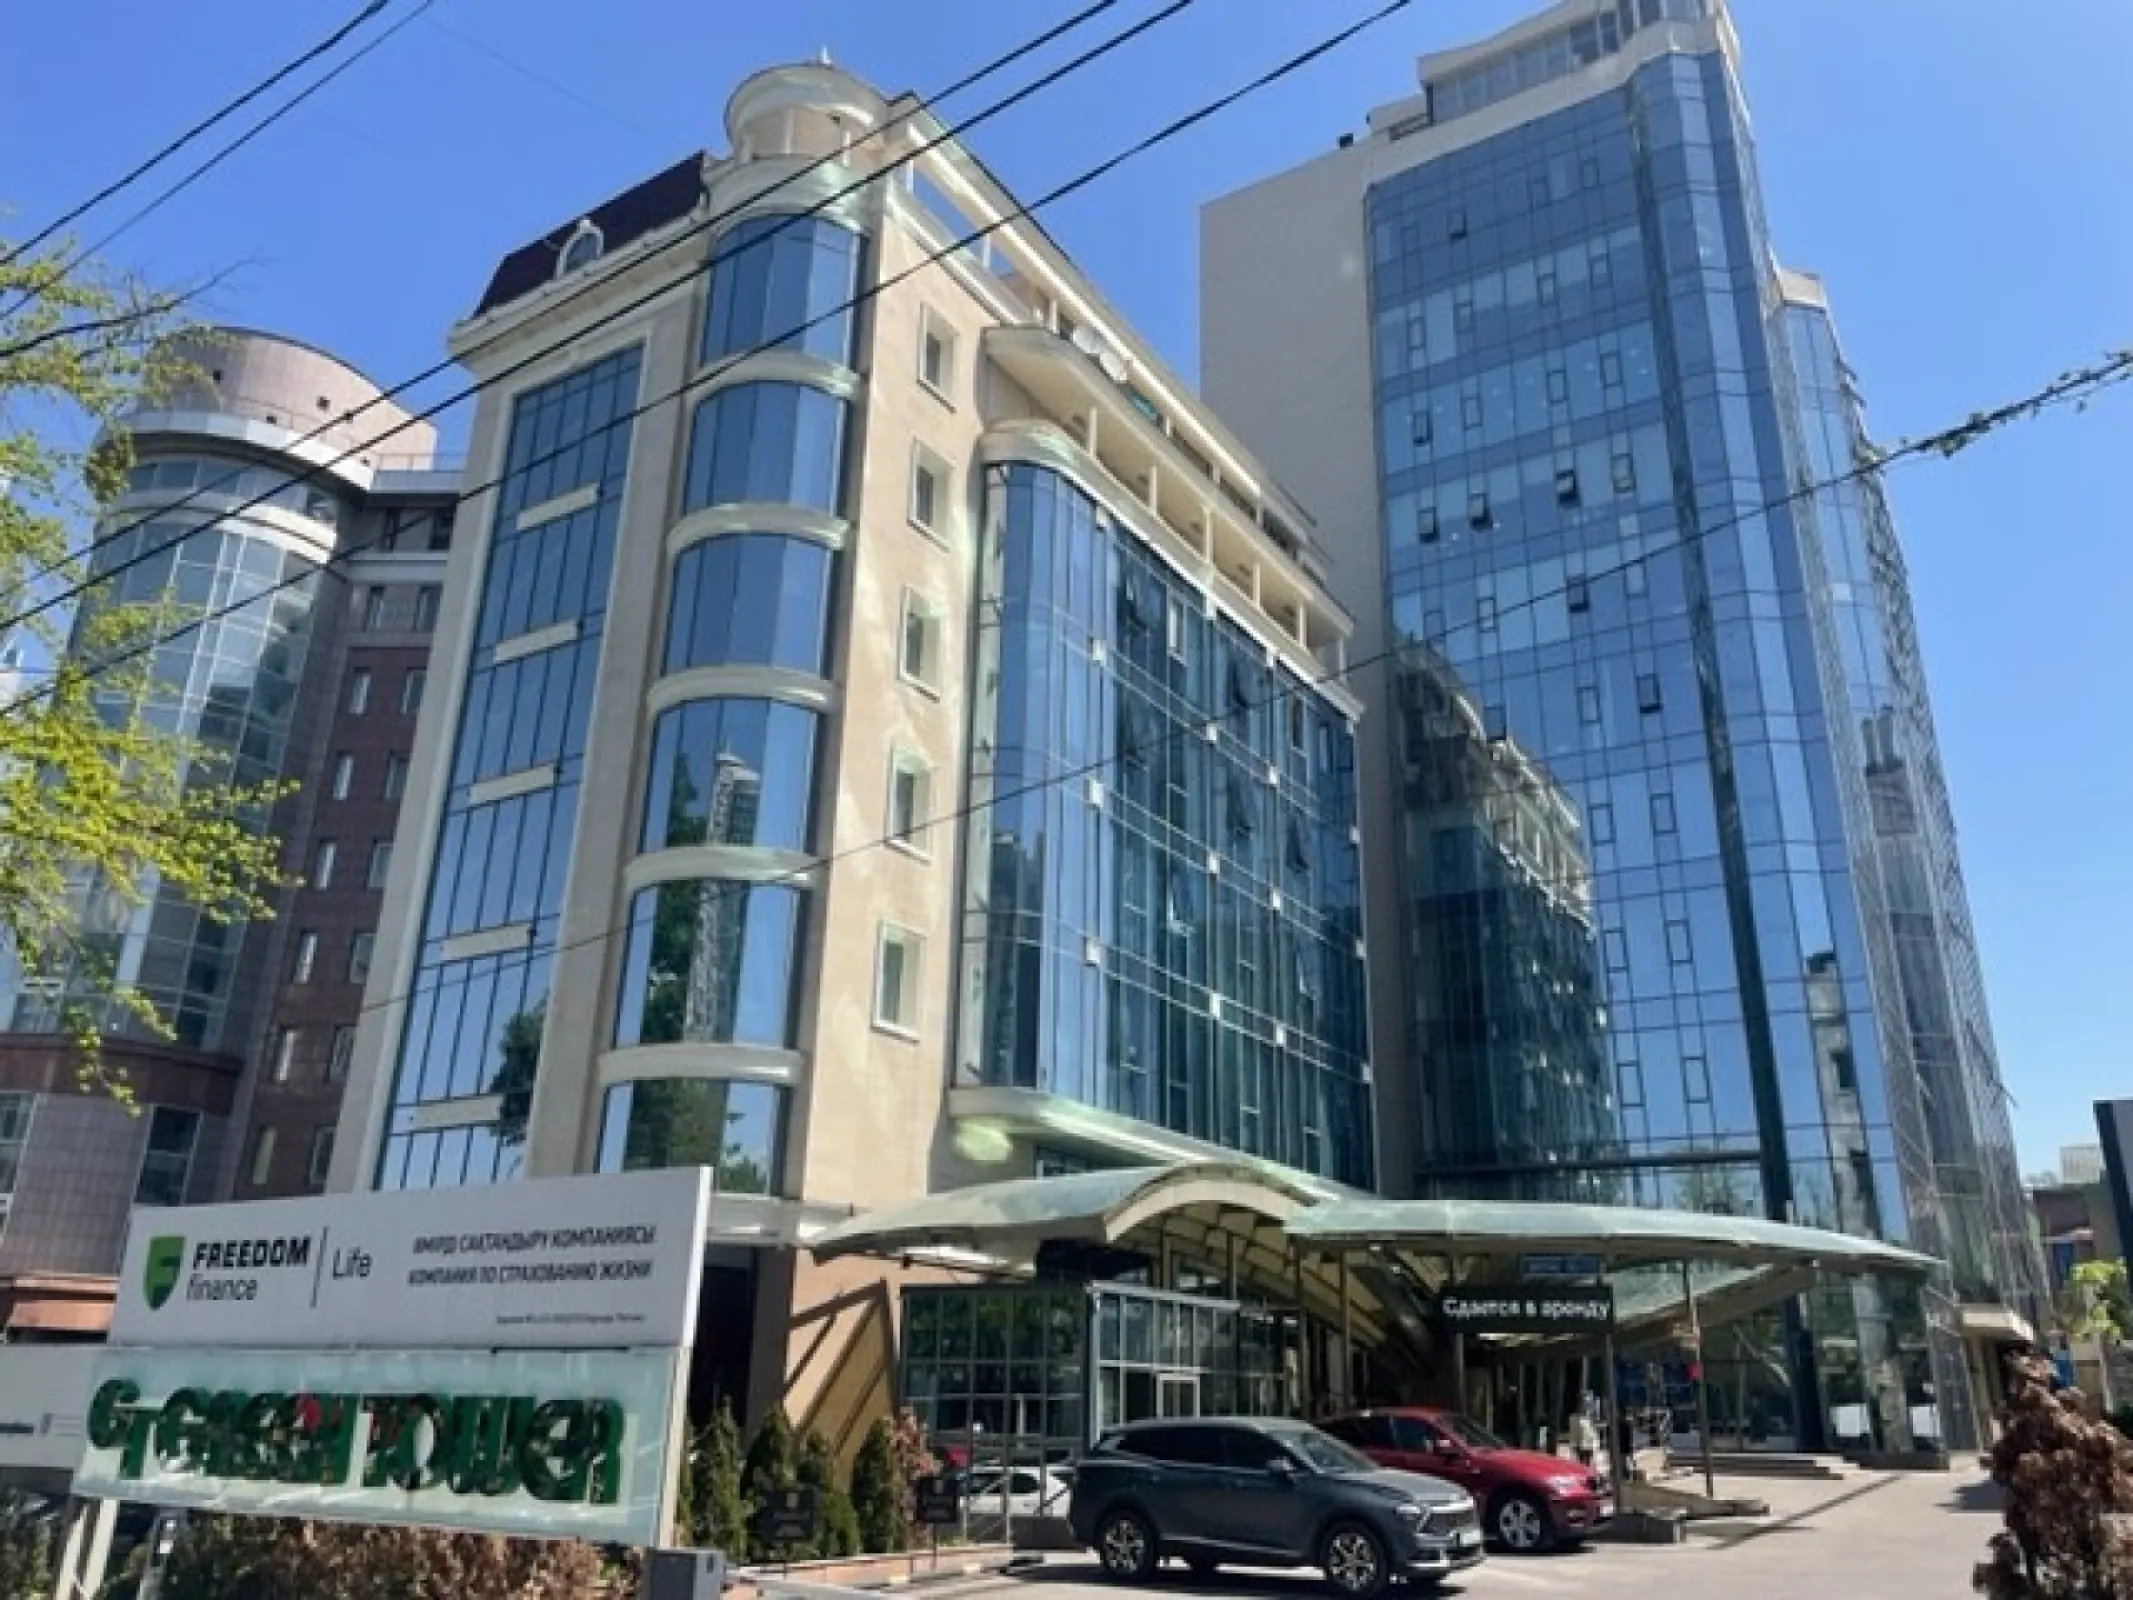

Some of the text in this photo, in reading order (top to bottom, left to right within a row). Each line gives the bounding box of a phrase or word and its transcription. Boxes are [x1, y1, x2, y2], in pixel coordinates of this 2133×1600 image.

[193, 1236, 311, 1270] FREEDOM
[333, 1246, 372, 1279] Life
[480, 1266, 497, 1284] ПО
[600, 1259, 653, 1280] ЖИЗНИ
[187, 1272, 258, 1300] finance
[1525, 1299, 1538, 1317] в
